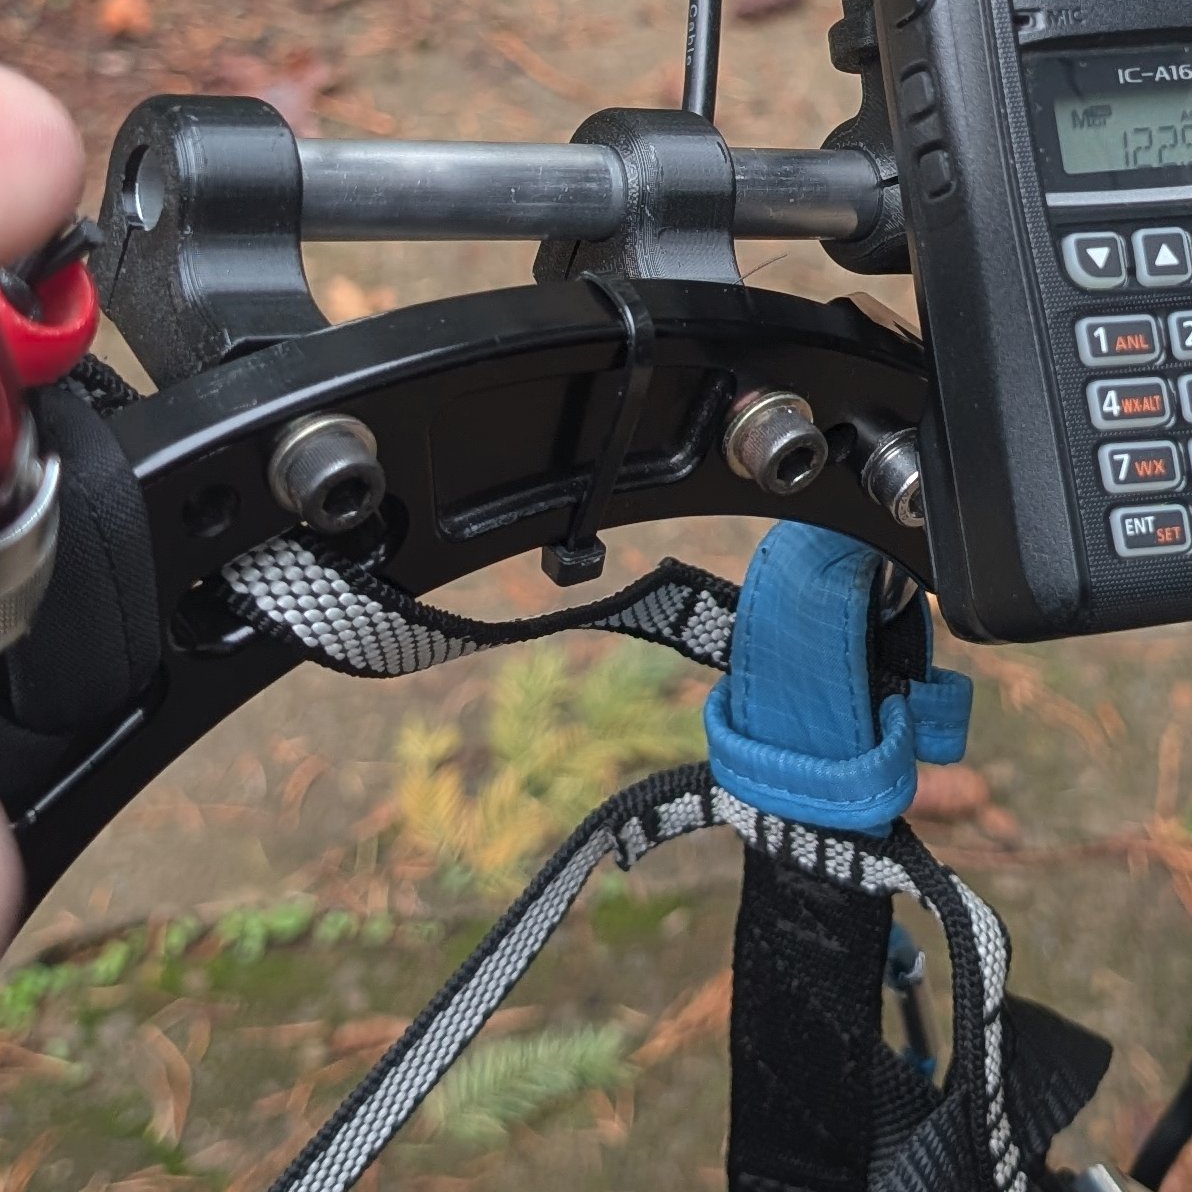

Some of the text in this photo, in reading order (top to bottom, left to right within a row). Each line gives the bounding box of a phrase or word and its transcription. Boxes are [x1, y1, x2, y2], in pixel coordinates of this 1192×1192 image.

[686, 4, 698, 66] Cable
[1093, 326, 1150, 355] 1 ANL
[1102, 389, 1121, 418] 4
[1112, 453, 1168, 481] 7 WX
[1124, 515, 1182, 544] ENT SET
